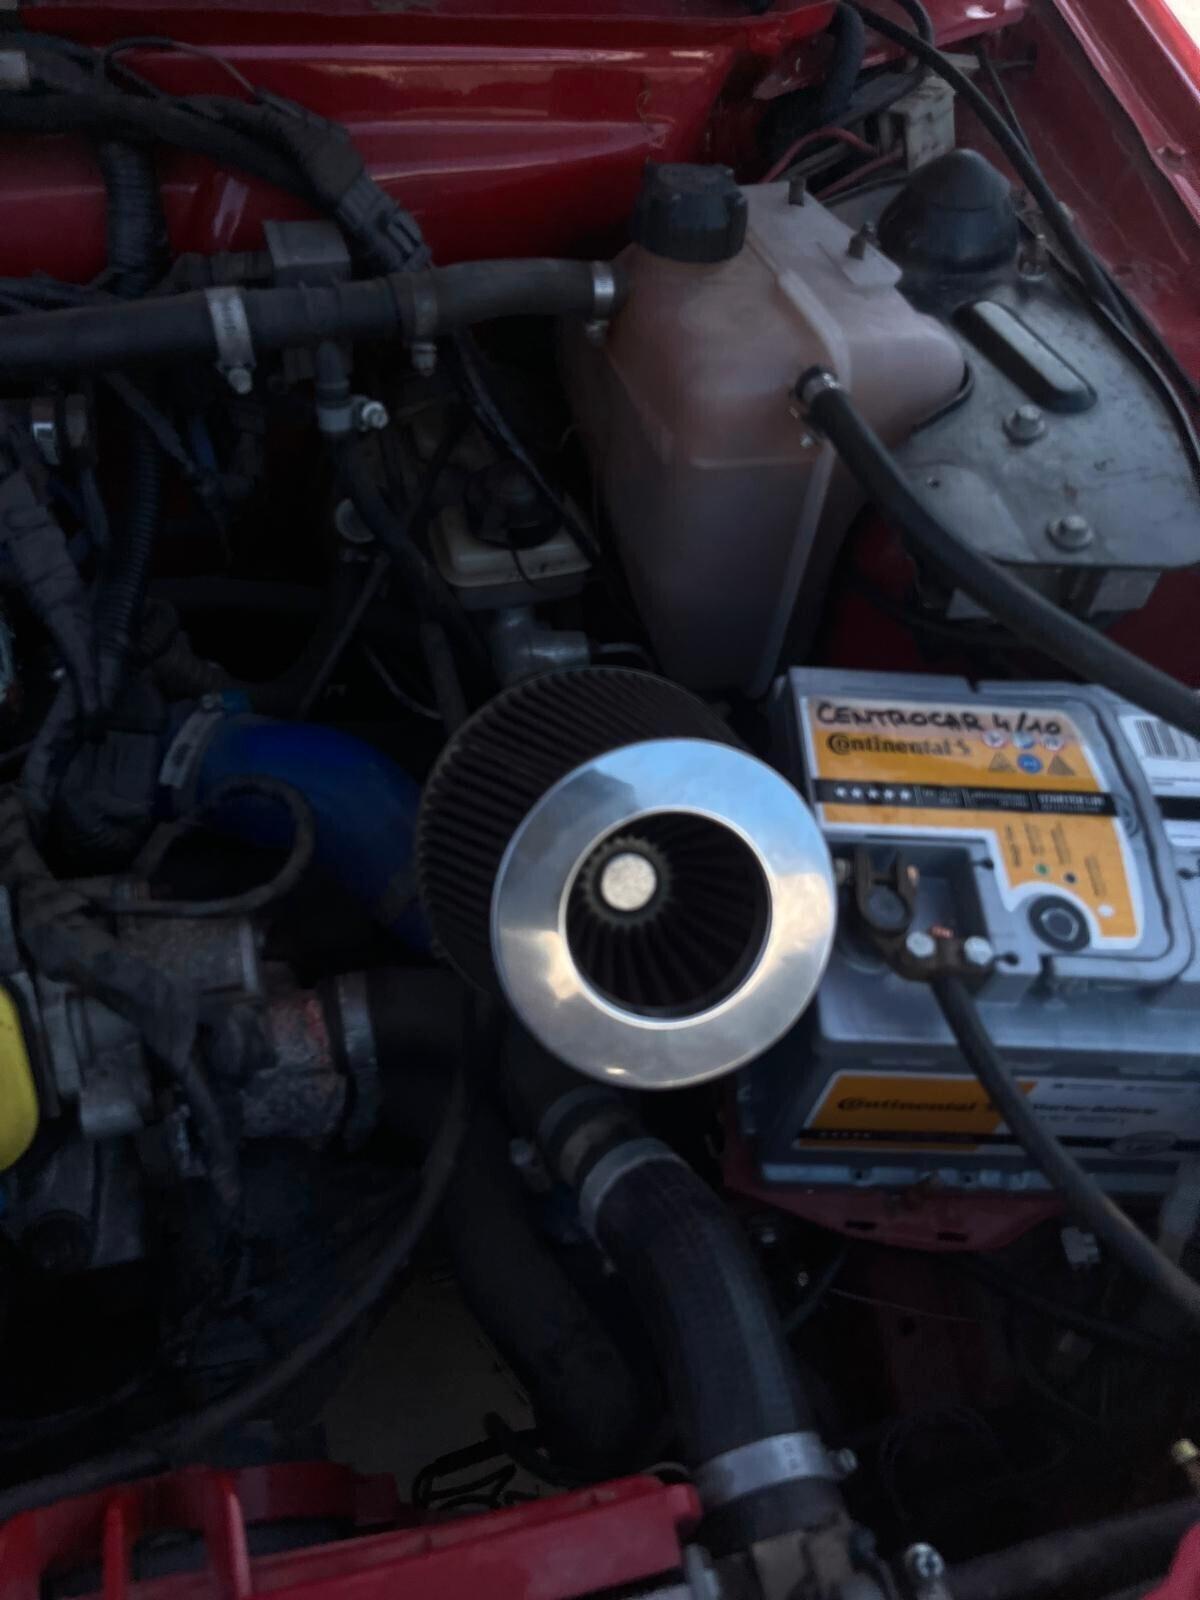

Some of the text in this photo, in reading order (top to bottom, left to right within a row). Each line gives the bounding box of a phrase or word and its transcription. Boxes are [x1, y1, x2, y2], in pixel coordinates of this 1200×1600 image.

[817, 701, 985, 732] CENTROCAR
[827, 732, 951, 755] Continental
[837, 1097, 977, 1112] Continental
